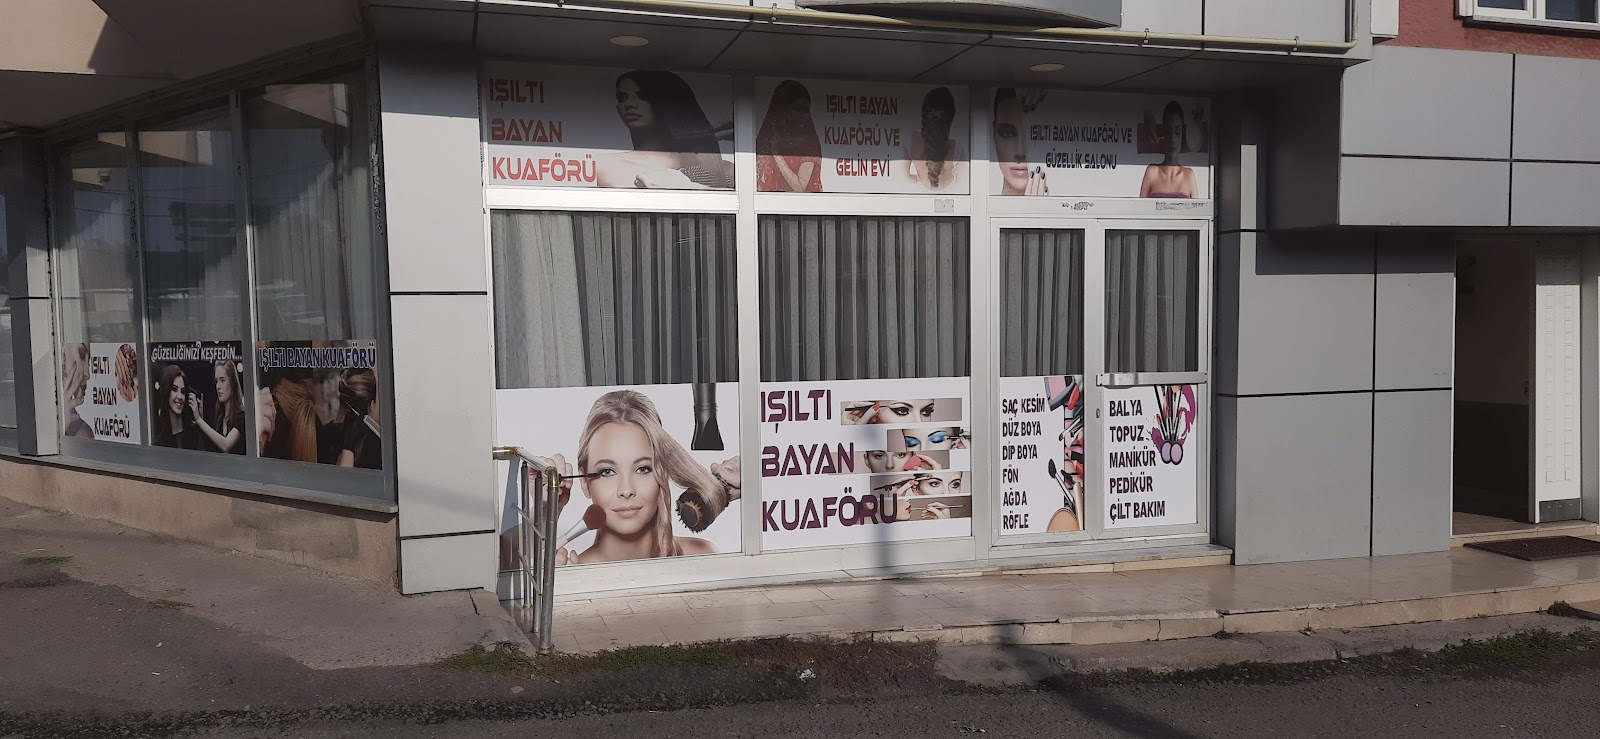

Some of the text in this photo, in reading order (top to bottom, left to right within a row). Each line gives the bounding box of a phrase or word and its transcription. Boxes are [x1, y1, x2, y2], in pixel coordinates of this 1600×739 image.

[489, 78, 545, 110] IŞILTI
[826, 94, 898, 119] IŞILTI BAYAN
[491, 117, 563, 144] BAYAN
[824, 122, 901, 147] KUAFÖRÜ VE
[1030, 123, 1132, 146] IŞILTI BAYAN KUAFÖRÜ VE
[492, 152, 597, 183] KUAFÖRÜ
[836, 153, 890, 177] GELİN EVİ
[1045, 148, 1117, 170] GÜZELLİK SALONU
[91, 356, 110, 380] IŞILTI
[259, 341, 377, 373] IŞILTI BAYAN KUAFÖRÜ
[92, 386, 118, 406] BAYAN
[1002, 393, 1046, 418] SAÇ KESİM
[1109, 399, 1143, 417] BALYA
[760, 389, 832, 434] IŞILTI
[93, 413, 131, 439] KUAFÖRÜ
[1002, 417, 1042, 438] DÜZ BOYA
[1109, 424, 1145, 443] TOPUZ
[761, 442, 855, 478] BAYAN
[1002, 440, 1038, 461] DİP BOYA
[1109, 445, 1157, 469] MANİKÜR
[1002, 464, 1019, 484] FÖN
[1109, 471, 1154, 495] PEDİKÜR
[1002, 486, 1028, 507] AĞDA
[762, 486, 898, 532] KUAFÖRÜ
[1003, 510, 1030, 530] RÖFLE
[1109, 498, 1166, 525] ÇİLT BAKIM
